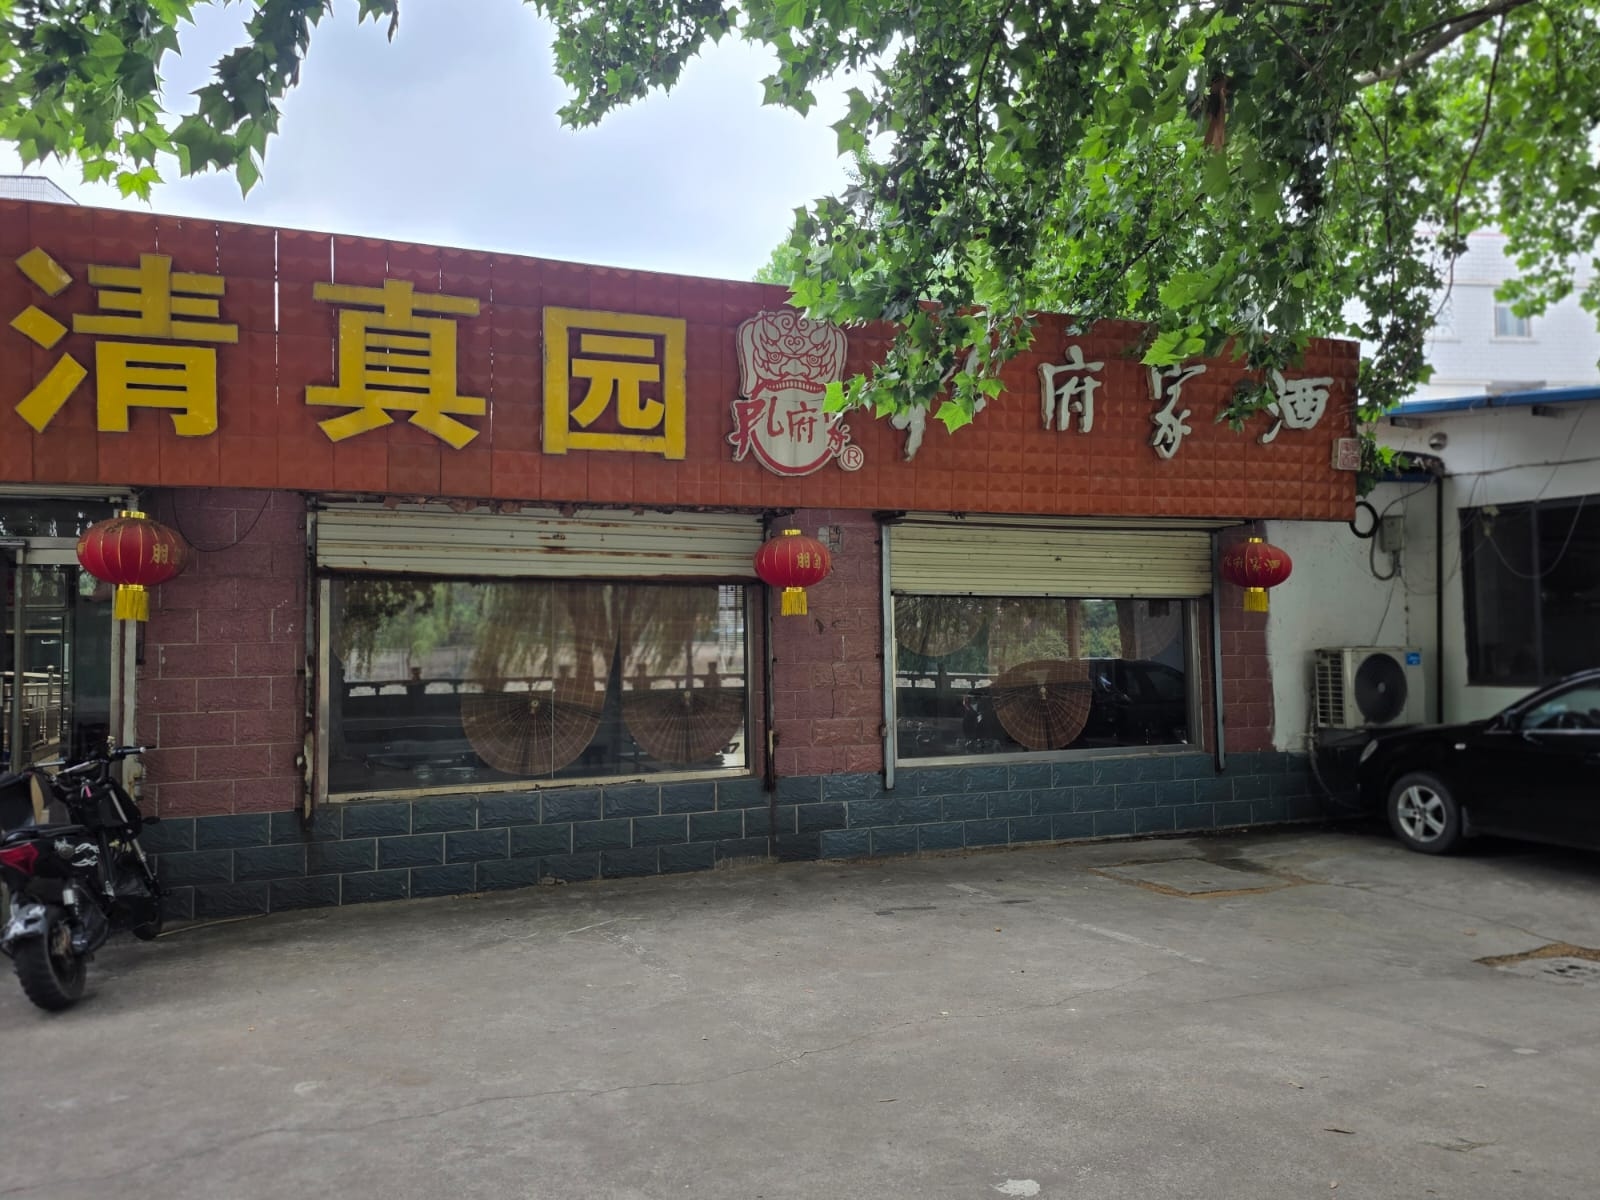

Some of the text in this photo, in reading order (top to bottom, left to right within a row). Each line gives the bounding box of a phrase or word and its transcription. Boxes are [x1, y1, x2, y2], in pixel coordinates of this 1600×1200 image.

[9, 246, 687, 459] 清真园
[891, 345, 1334, 461] 府家酒
